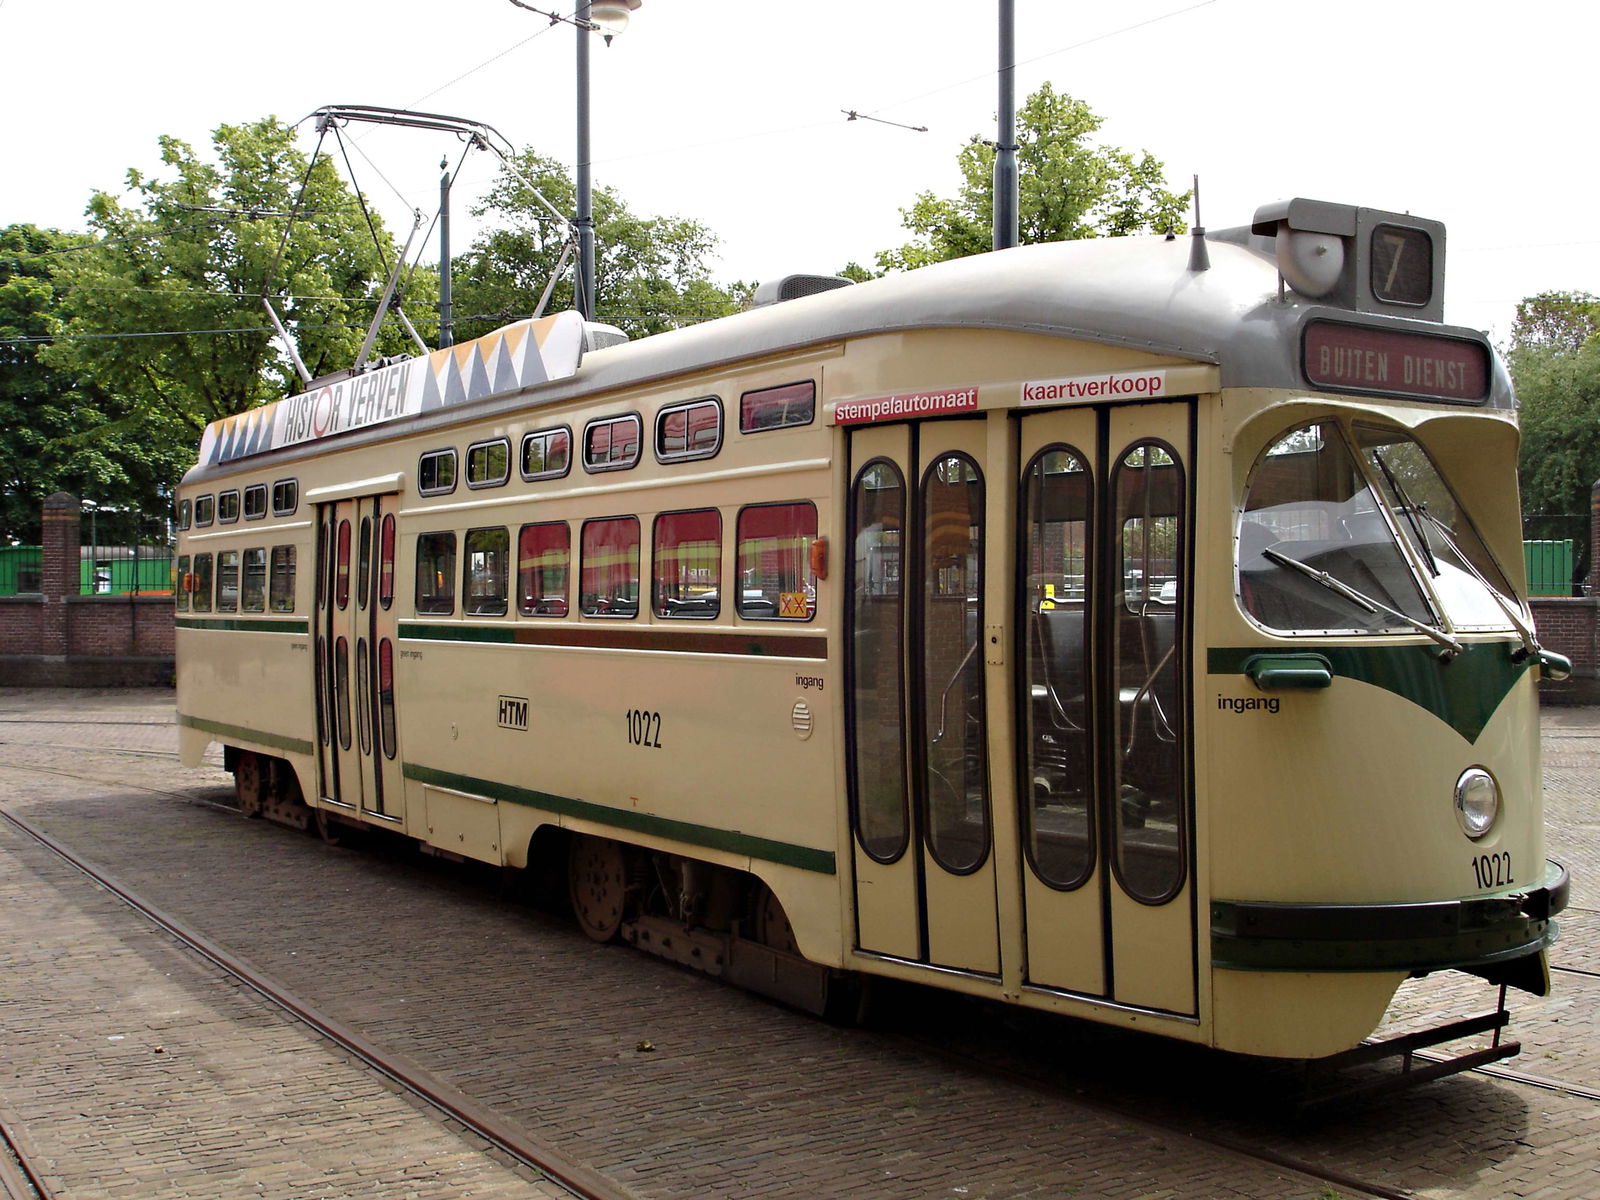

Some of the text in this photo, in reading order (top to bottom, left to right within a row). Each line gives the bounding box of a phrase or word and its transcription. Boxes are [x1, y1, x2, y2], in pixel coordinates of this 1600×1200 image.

[1383, 234, 1406, 293] 7
[1319, 345, 1467, 391] BUITEN DIENST
[283, 363, 411, 443] HISTOR VERVEN
[836, 389, 975, 421] stempelautomaat
[1023, 374, 1162, 402] kaartverkoop
[795, 672, 824, 691] ingang
[498, 699, 528, 727] HTM
[1217, 693, 1280, 714] ingang
[626, 708, 662, 749] 1022
[1471, 851, 1514, 889] 1022
